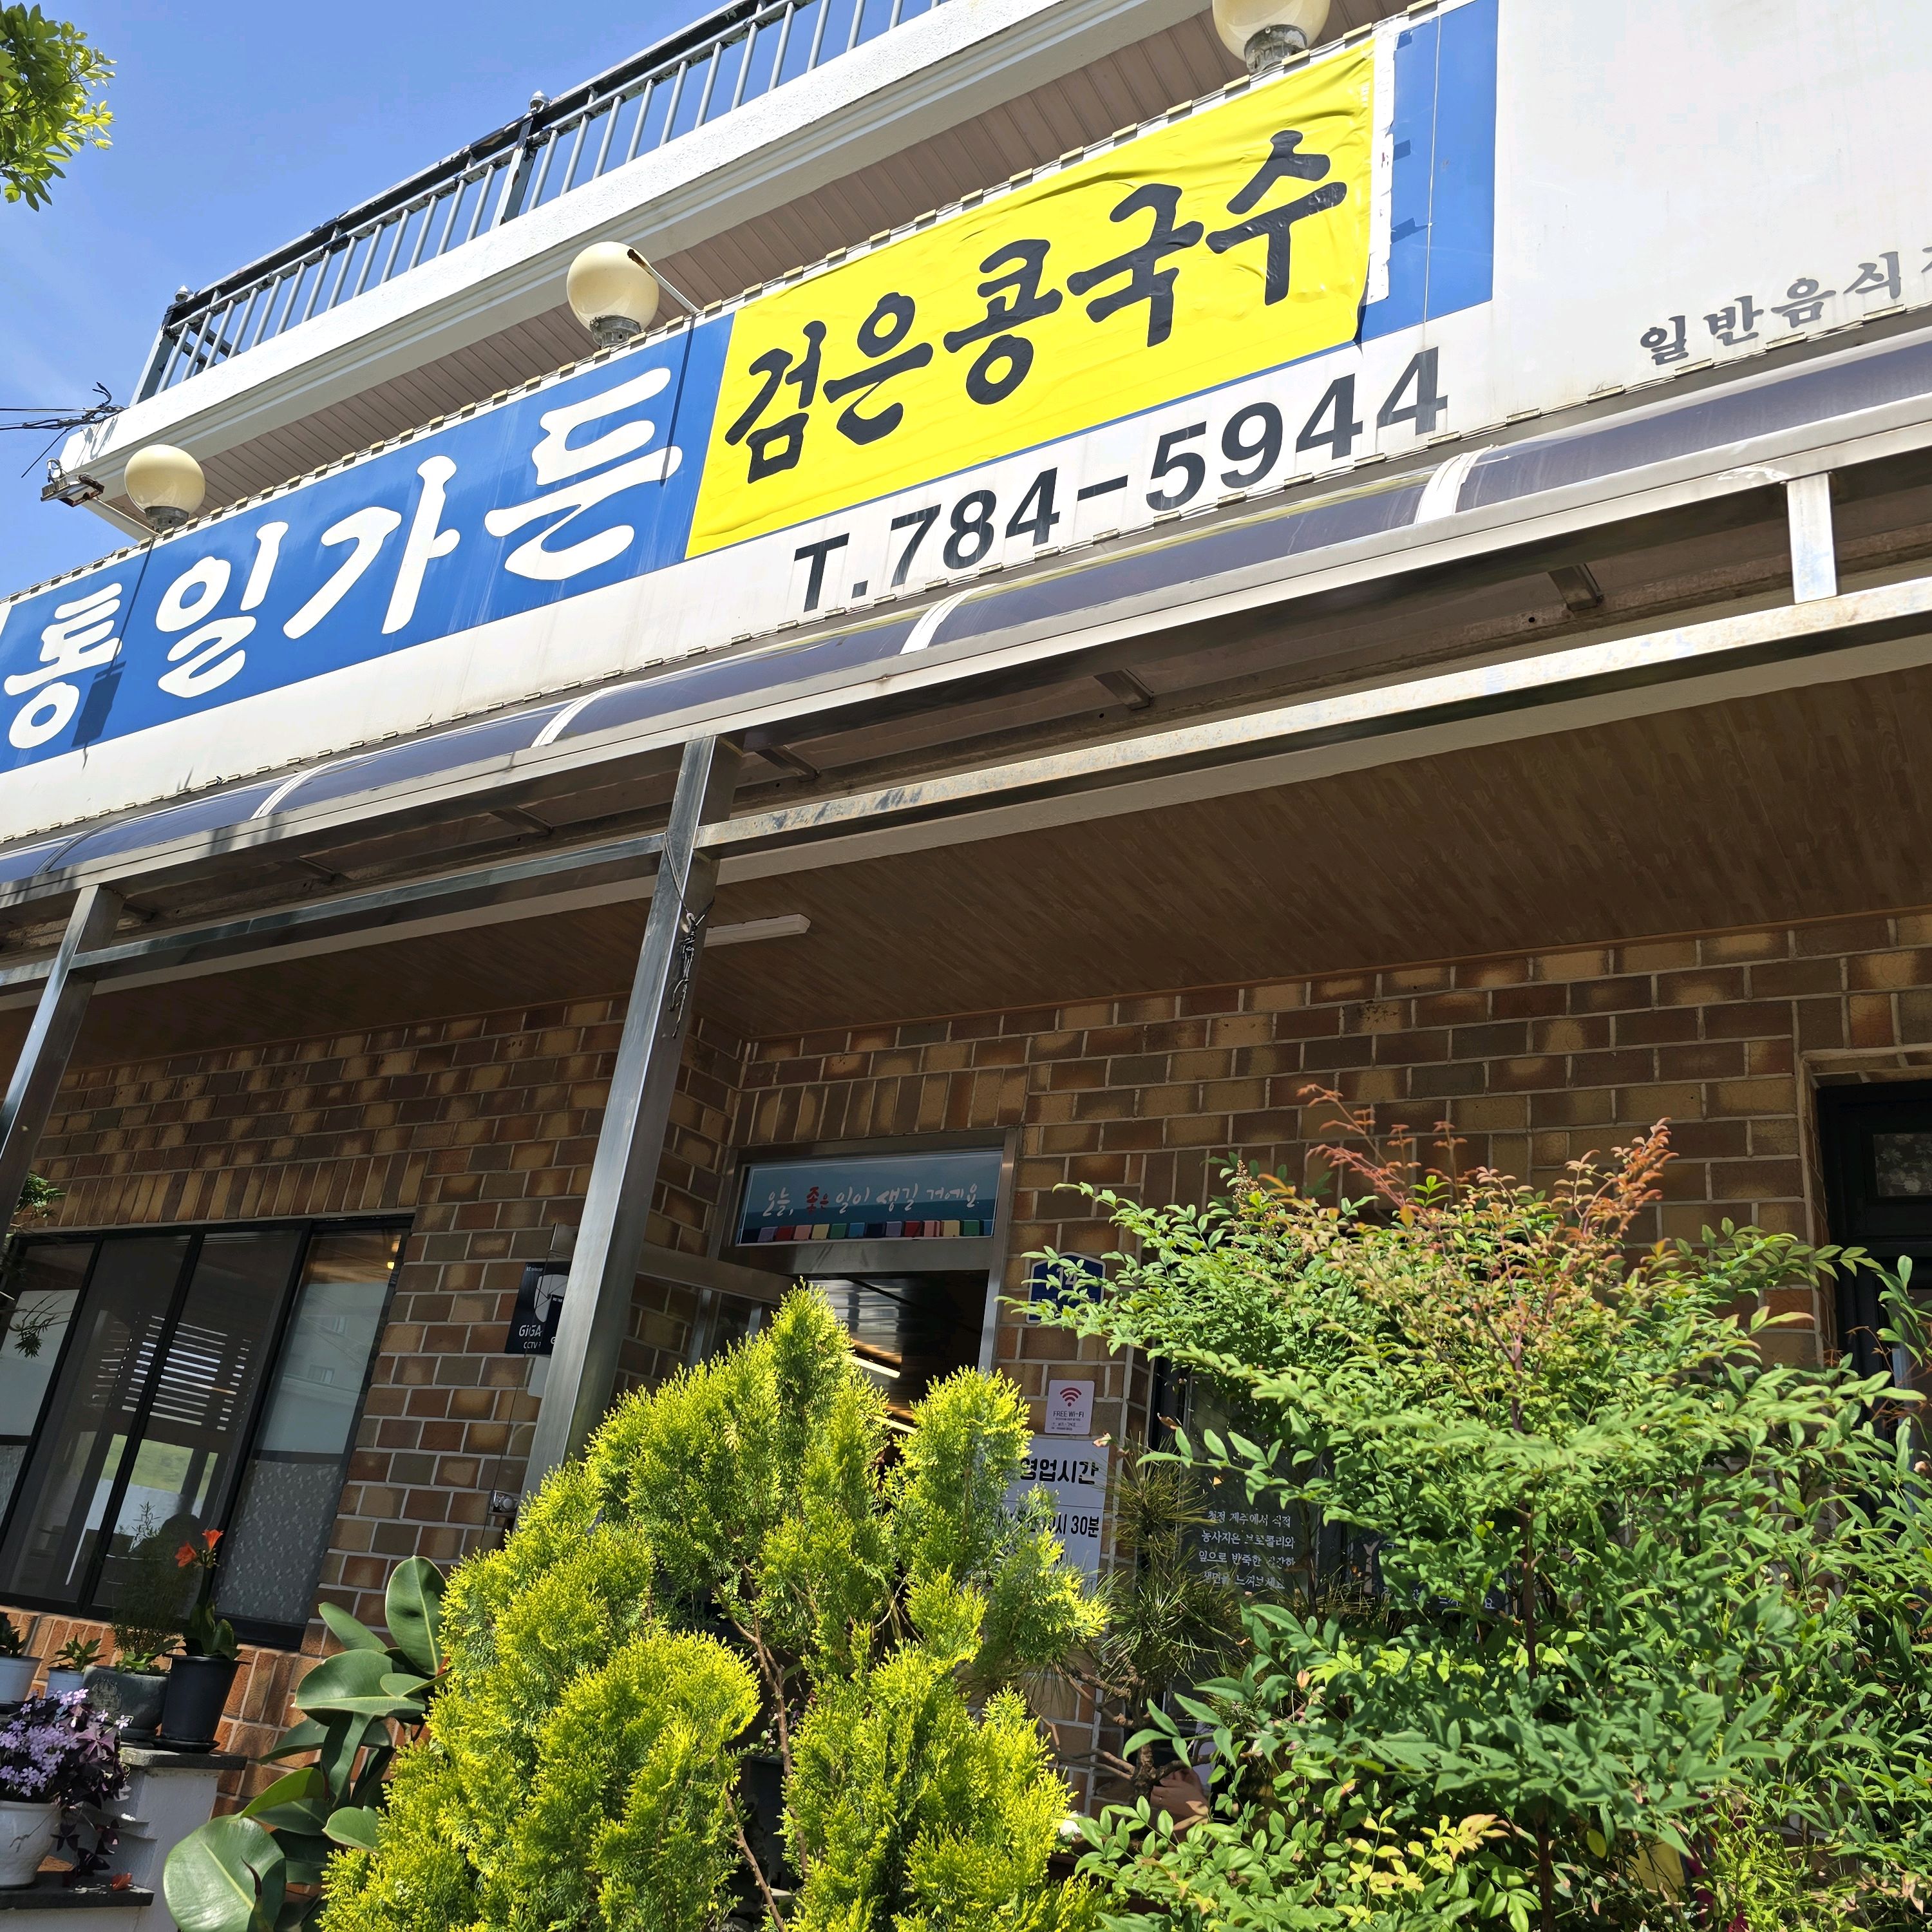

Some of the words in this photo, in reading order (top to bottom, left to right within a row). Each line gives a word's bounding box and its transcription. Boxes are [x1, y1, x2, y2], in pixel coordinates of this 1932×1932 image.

[5, 368, 683, 750] 통일가든
[806, 1186, 829, 1215] 좋은
[835, 1186, 870, 1214] 일이
[876, 1183, 918, 1211] 생길
[1020, 1457, 1099, 1484] 영업시간
[1071, 1515, 1099, 1538] 30분
[1201, 1530, 1241, 1544] 농사지은
[1198, 1550, 1227, 1563] 잎으로
[1231, 1553, 1262, 1567] 반죽한
